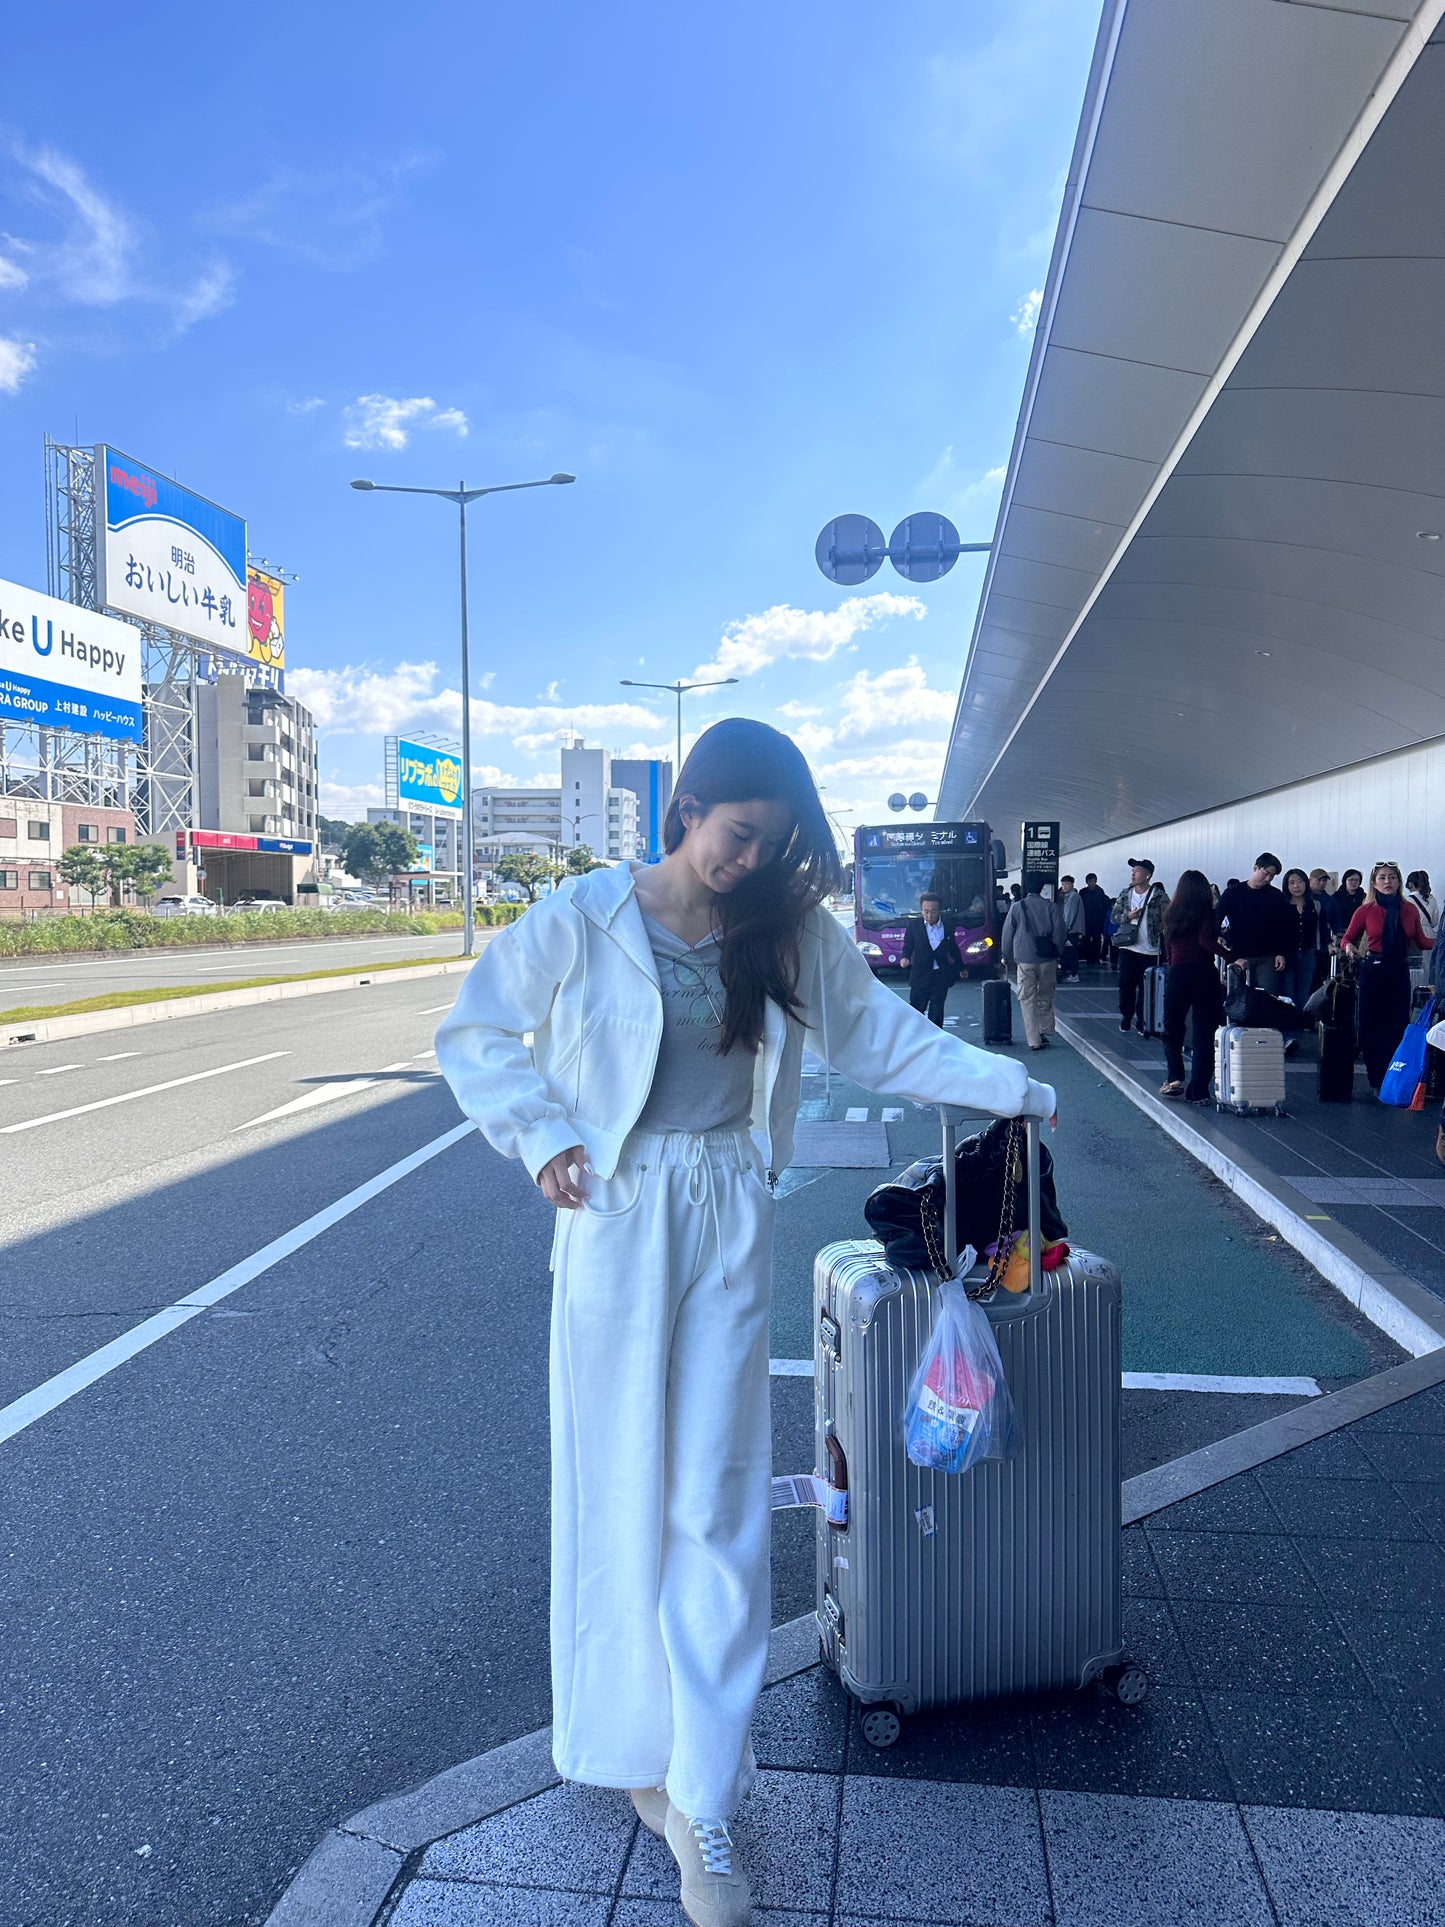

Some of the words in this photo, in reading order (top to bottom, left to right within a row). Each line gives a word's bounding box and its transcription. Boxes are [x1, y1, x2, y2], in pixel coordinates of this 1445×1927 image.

[110, 466, 157, 508] meiji
[171, 545, 195, 575] 明治
[125, 553, 236, 627] おいしい牛乳
[32, 614, 53, 656] U
[61, 630, 125, 676] Happy
[12, 683, 31, 696] Happy
[13, 695, 49, 714] GROUP
[54, 699, 88, 718] 上村建設
[93, 709, 135, 727] ハッピーハウス
[1027, 826, 1034, 839] 1
